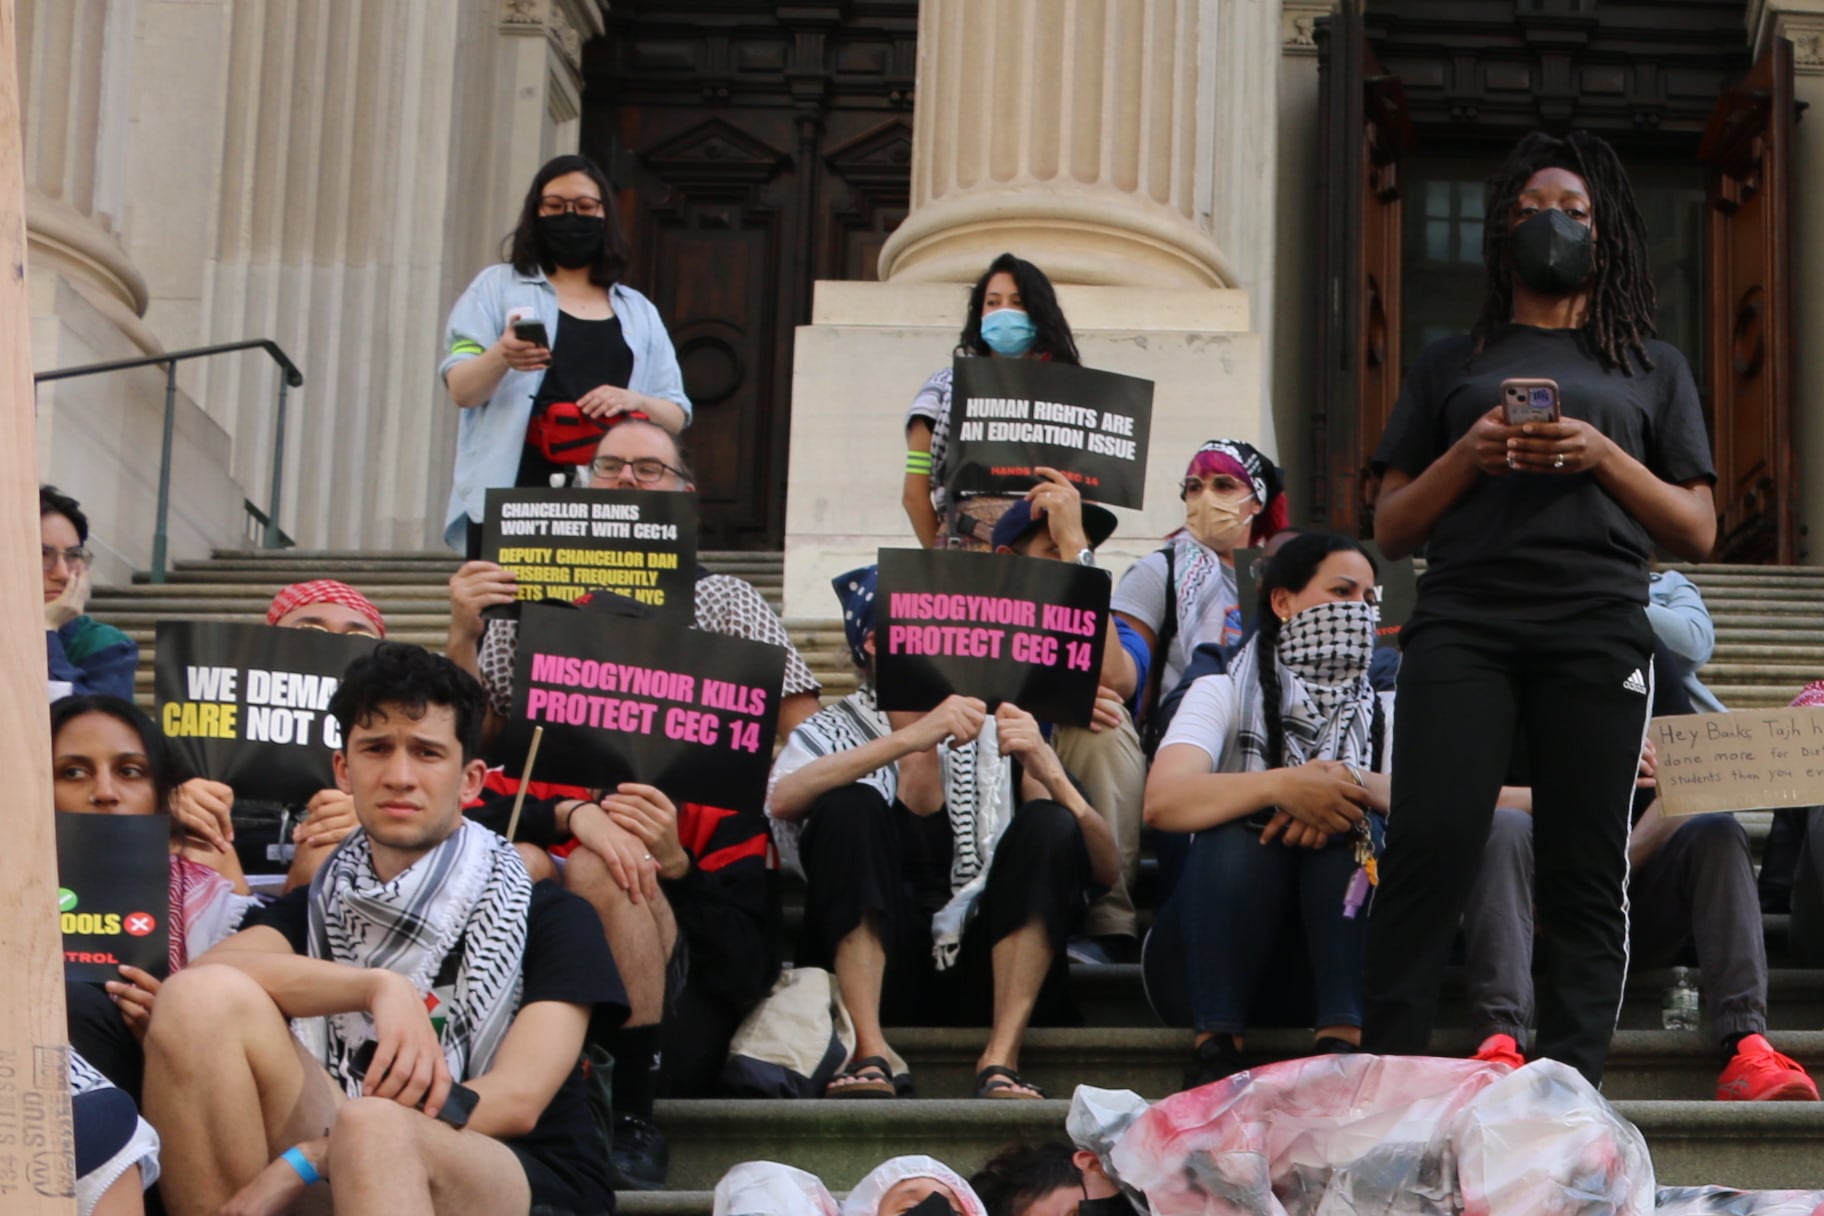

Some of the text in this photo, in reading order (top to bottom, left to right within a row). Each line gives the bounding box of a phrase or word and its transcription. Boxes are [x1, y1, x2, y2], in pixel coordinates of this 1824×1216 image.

[966, 398, 1134, 436] HUMAN RIGHTS ARE
[960, 421, 1136, 461] AN EDUCATION ISSUE
[501, 503, 639, 520] CHANCELLOR BANKS
[501, 520, 677, 540] WON'T MEET WITH CEC14
[498, 548, 677, 569] DEPUTY CHANCELLOR DAN
[574, 568, 658, 586] FREQUENTLY
[890, 593, 1096, 637] MISOGYNOIR KILLS
[889, 625, 1091, 672] PROTECT CEC 14
[187, 666, 338, 710] WE DEMA
[531, 653, 767, 716] MISOGYNOIR KILLS
[163, 702, 237, 739] CARE
[246, 705, 314, 745] NOT
[526, 688, 760, 753] PROTECT CEC 14
[1660, 724, 1699, 748] Hey
[1763, 718, 1801, 740] Tajh
[1664, 753, 1702, 768] done
[1714, 751, 1755, 761] more
[1771, 749, 1789, 759] for
[1671, 771, 1721, 786] students
[1731, 770, 1760, 781] than
[1769, 769, 1792, 784] you
[22, 1091, 46, 1148] STUD
